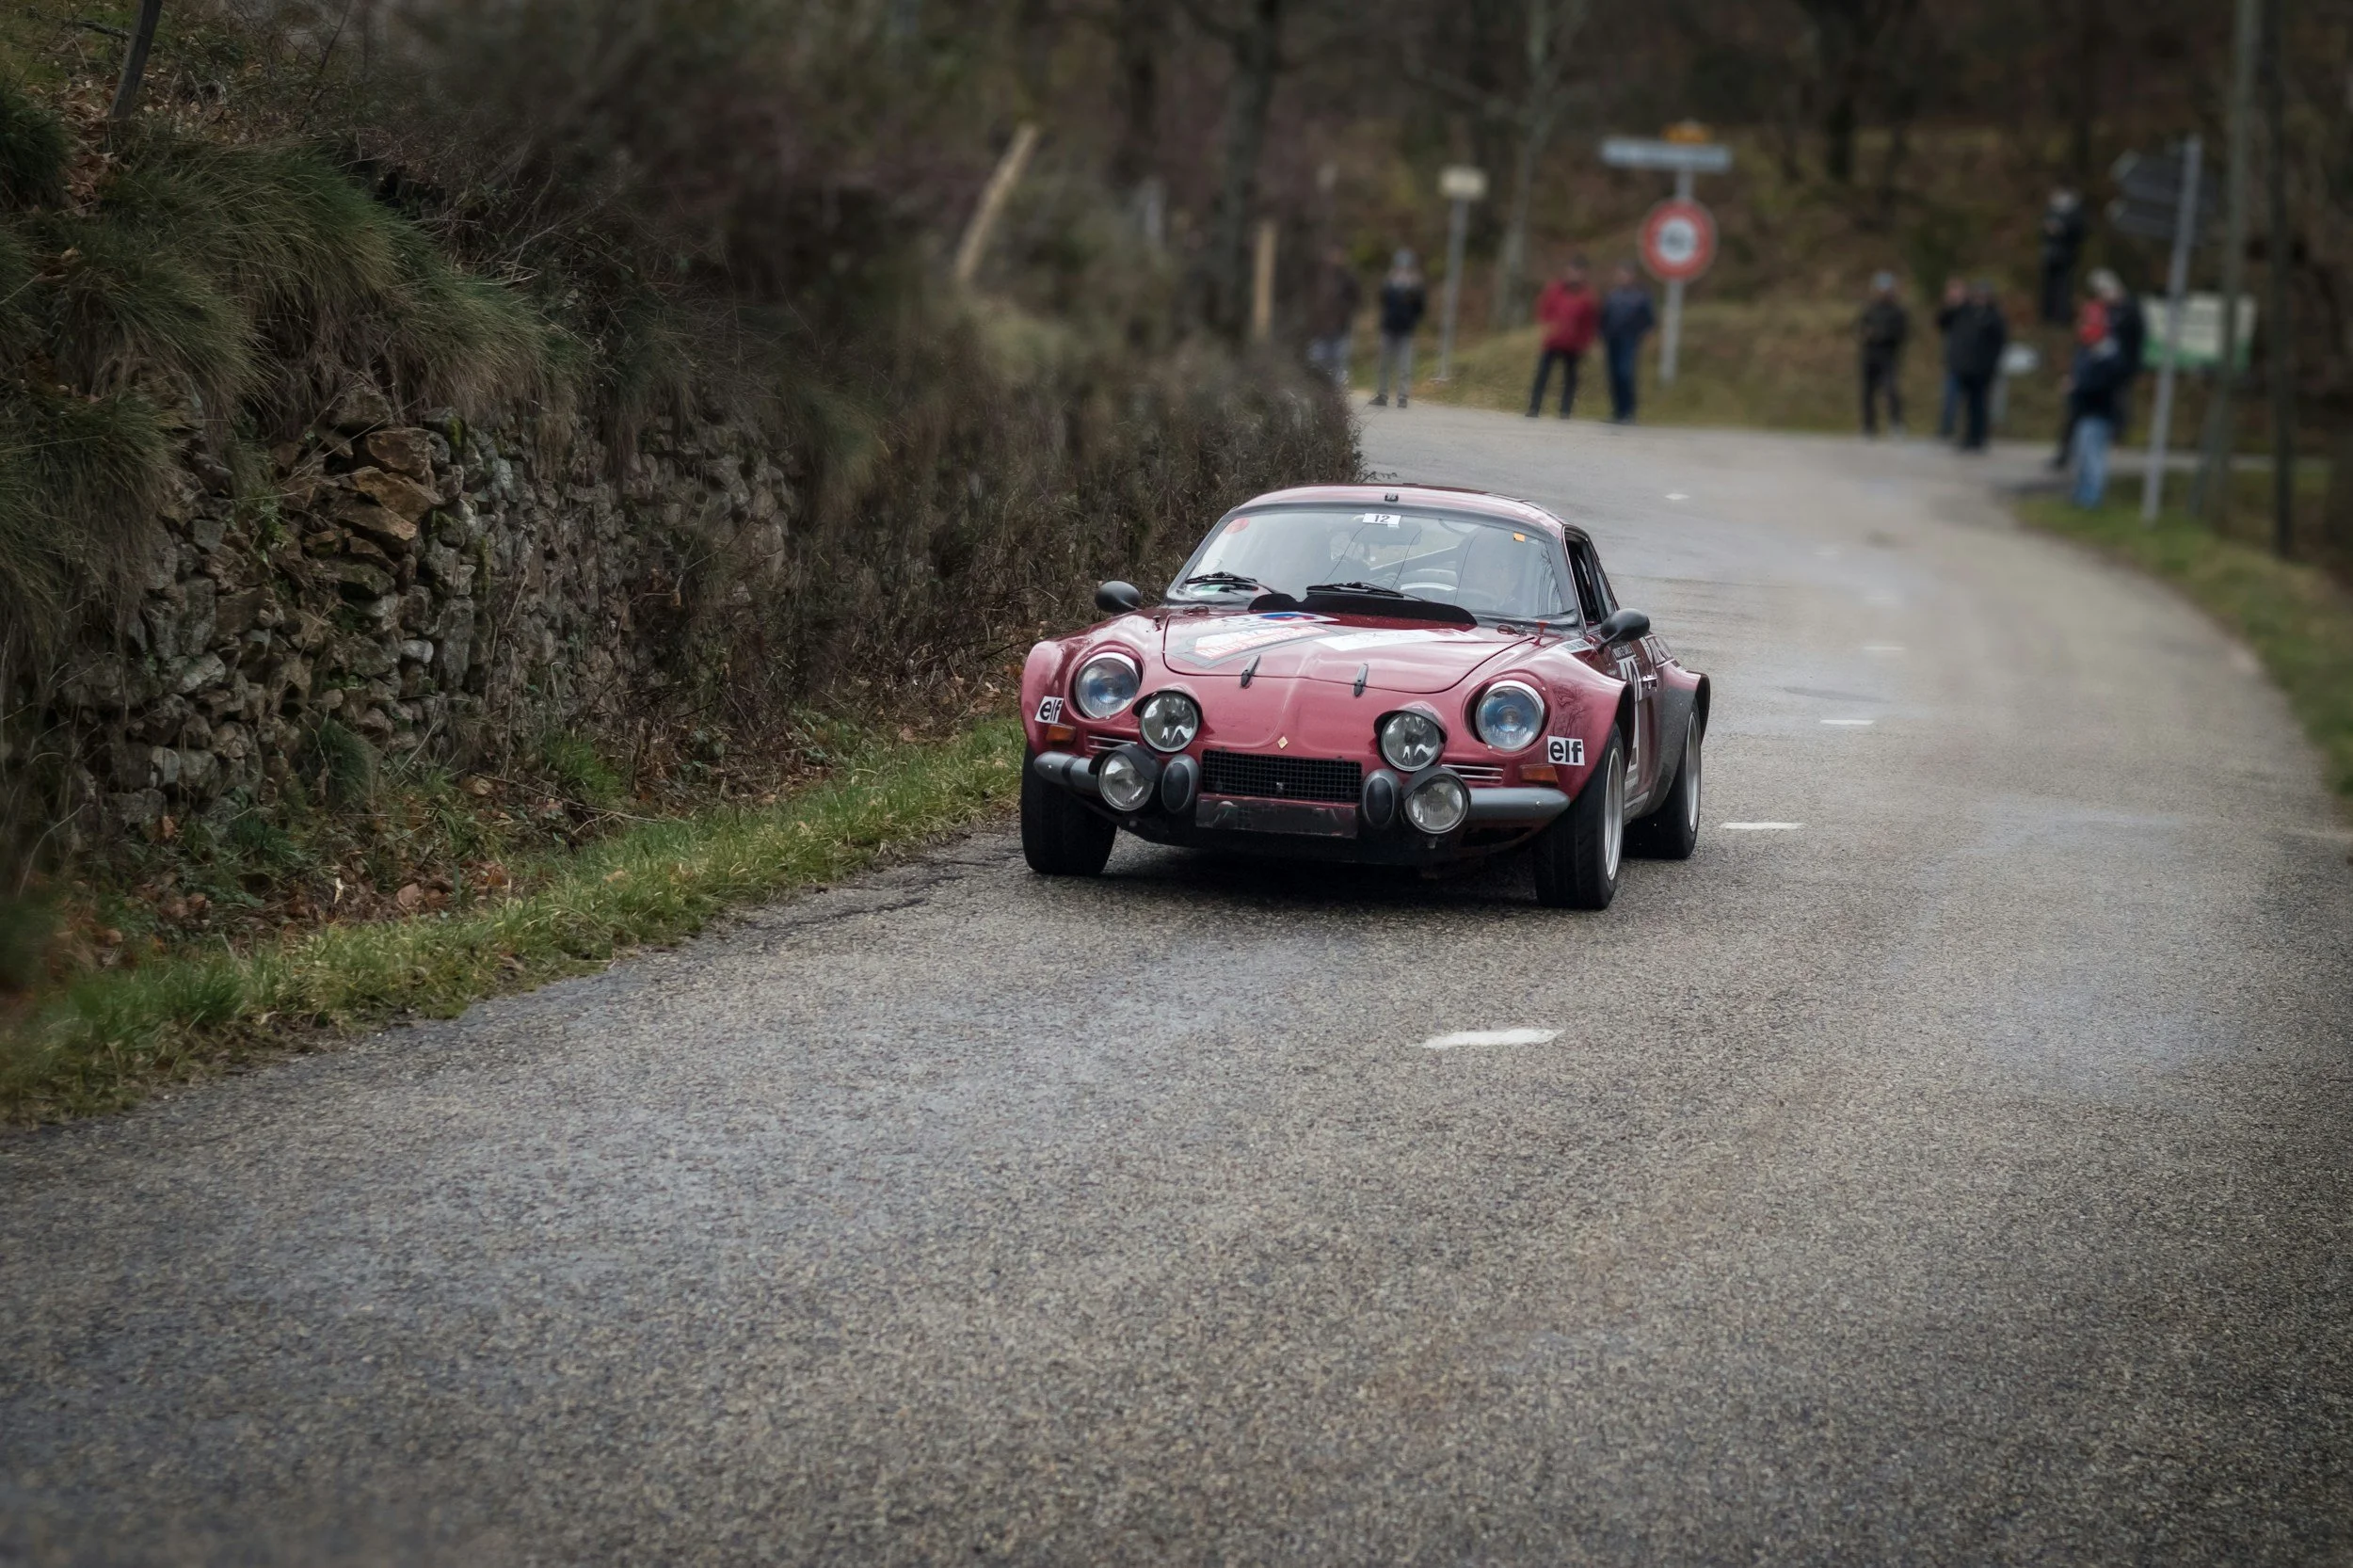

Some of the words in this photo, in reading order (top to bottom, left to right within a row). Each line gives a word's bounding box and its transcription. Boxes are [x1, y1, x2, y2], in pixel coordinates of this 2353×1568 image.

[1374, 514, 1391, 523] 12
[1039, 698, 1063, 722] elf
[1549, 740, 1582, 763] elf
